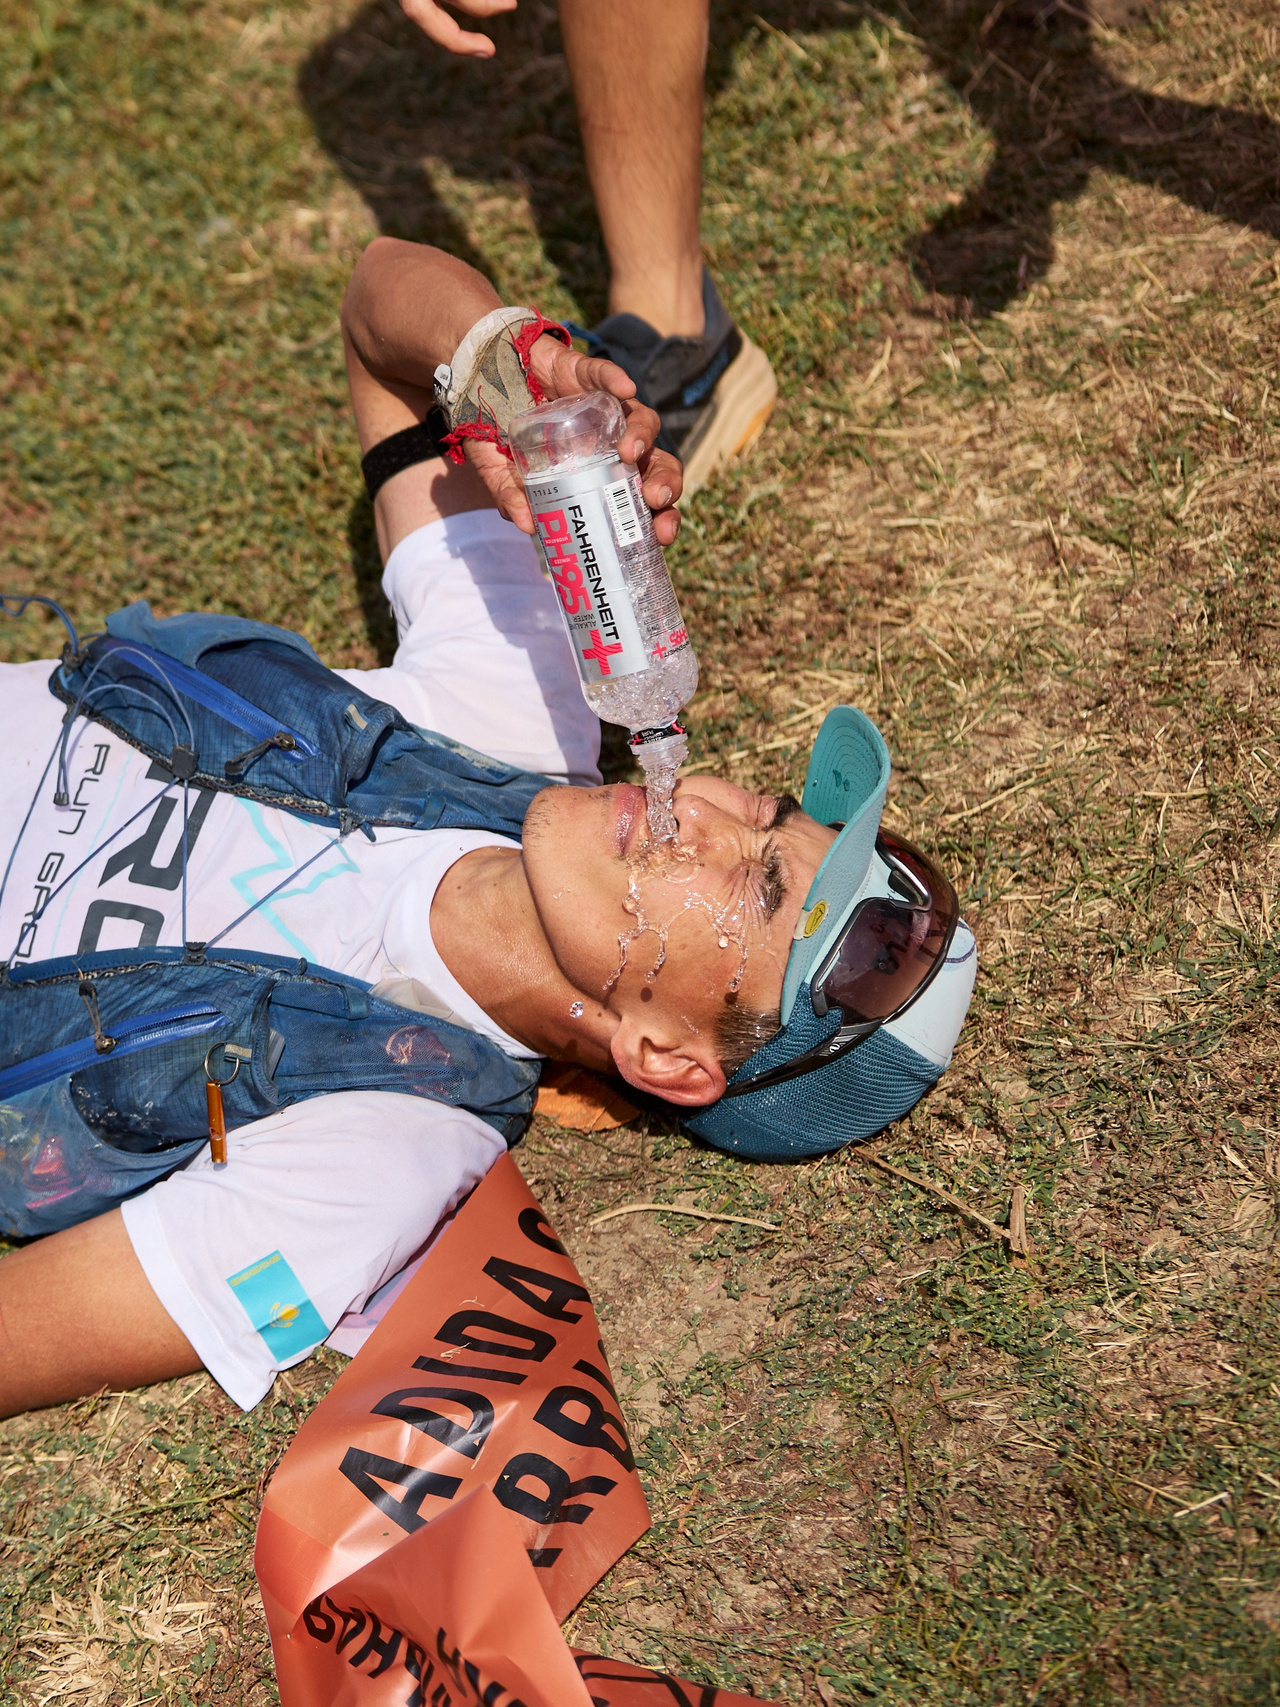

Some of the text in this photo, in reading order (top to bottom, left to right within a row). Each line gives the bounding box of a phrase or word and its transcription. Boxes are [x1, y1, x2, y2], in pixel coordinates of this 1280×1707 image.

[533, 487, 559, 497] STILL
[568, 504, 620, 640] FAHRENHEIT
[573, 613, 596, 622] WATER
[569, 620, 597, 631] ALKALINE
[15, 743, 111, 968] RUN GRO
